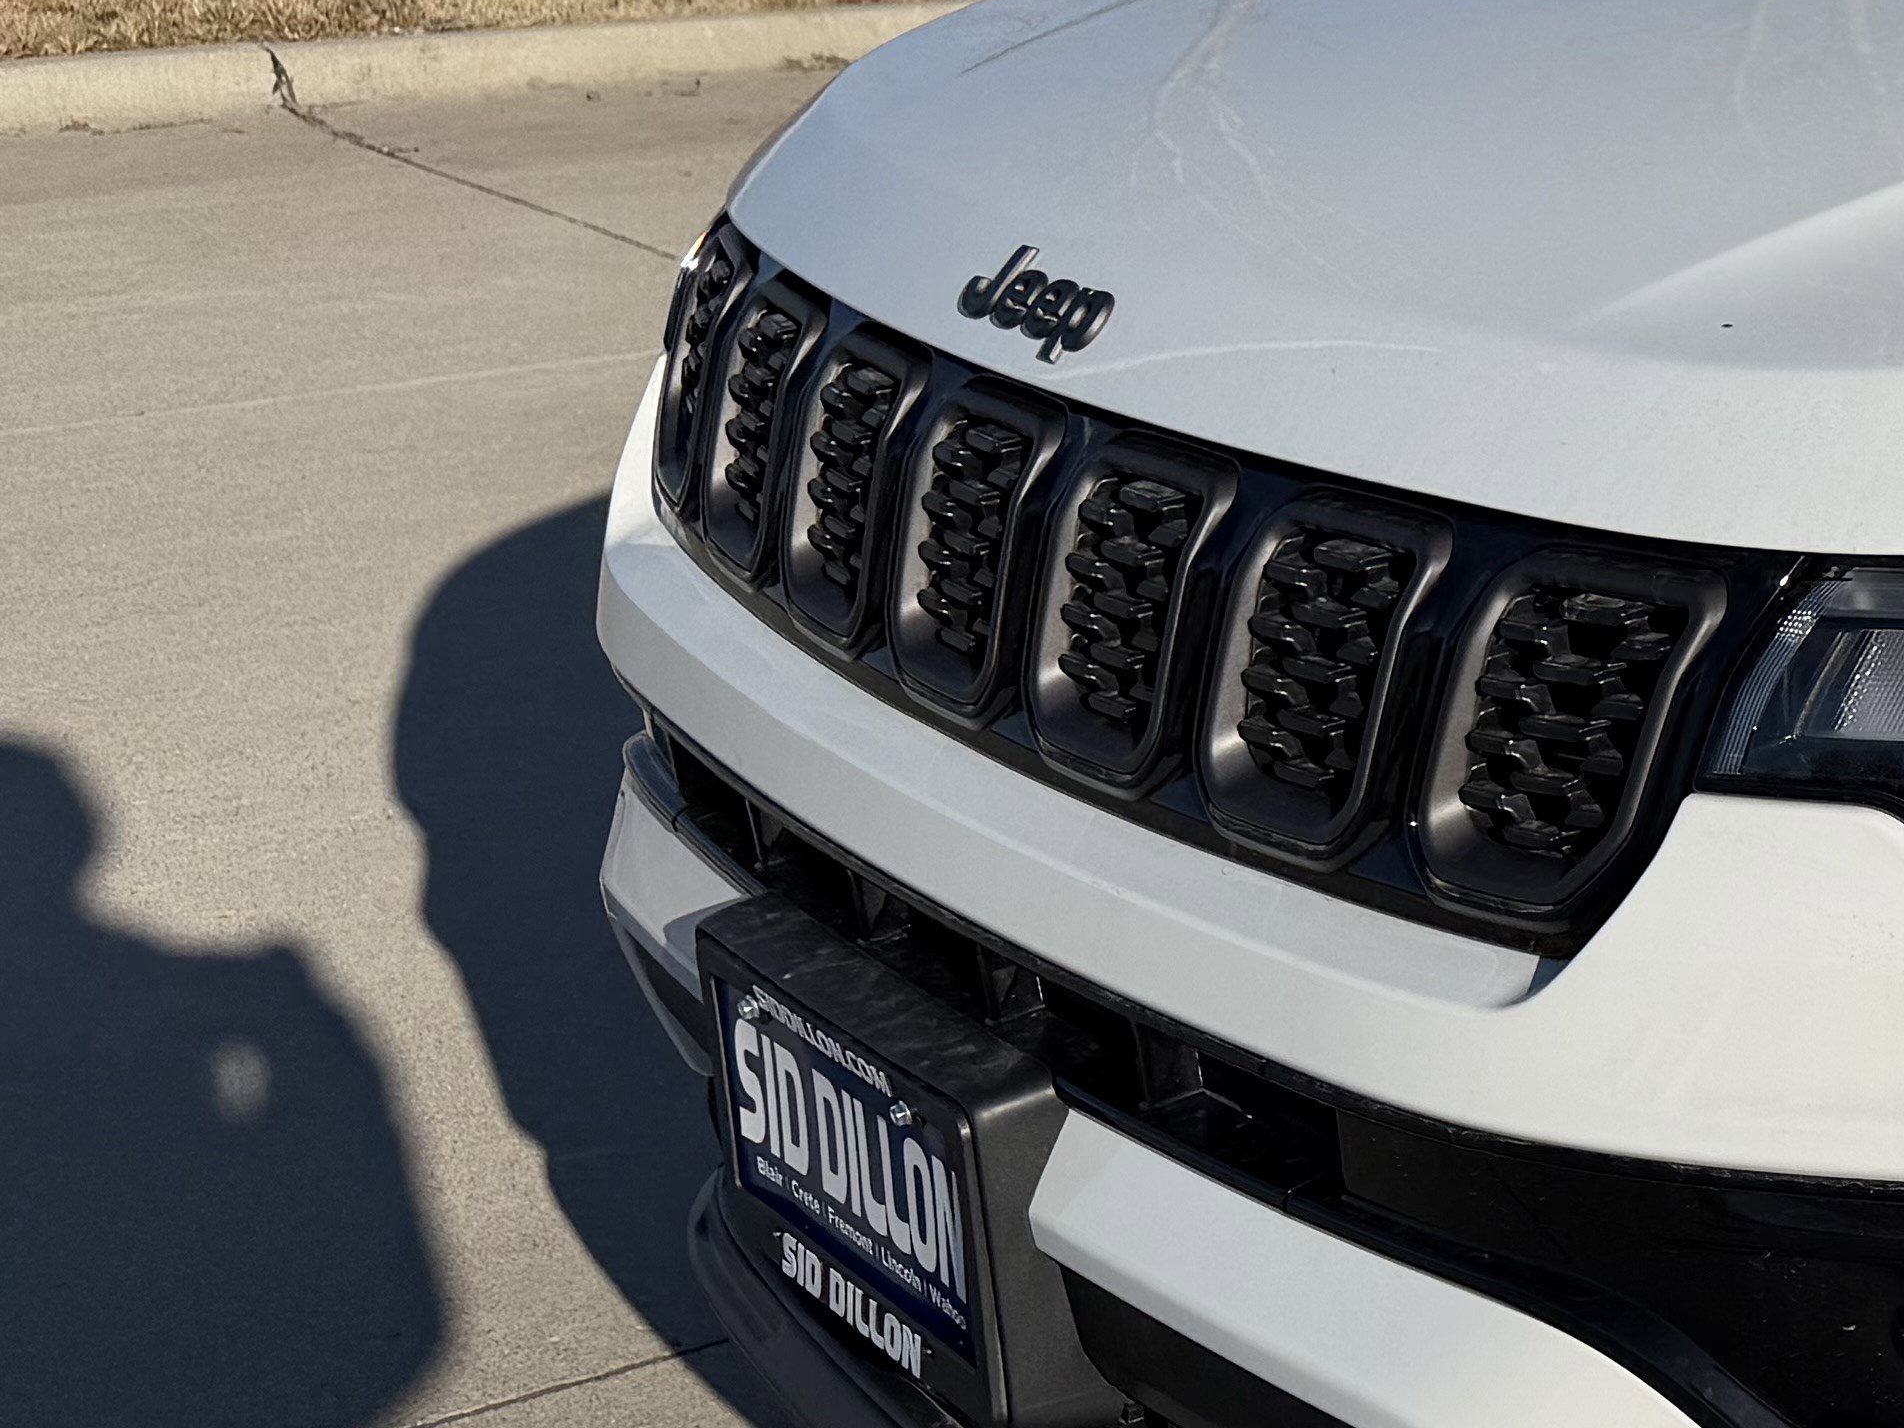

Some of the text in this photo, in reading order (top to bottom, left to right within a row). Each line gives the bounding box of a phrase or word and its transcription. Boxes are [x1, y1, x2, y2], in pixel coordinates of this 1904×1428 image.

[957, 245, 1116, 365] Jeep
[752, 984, 893, 1098] SIDDILLON.COM
[734, 1018, 967, 1304] SID DILLON
[756, 1156, 967, 1330] Blair Crete Fremont Lincoln Wahoo
[781, 1232, 922, 1380] SID DILLON
